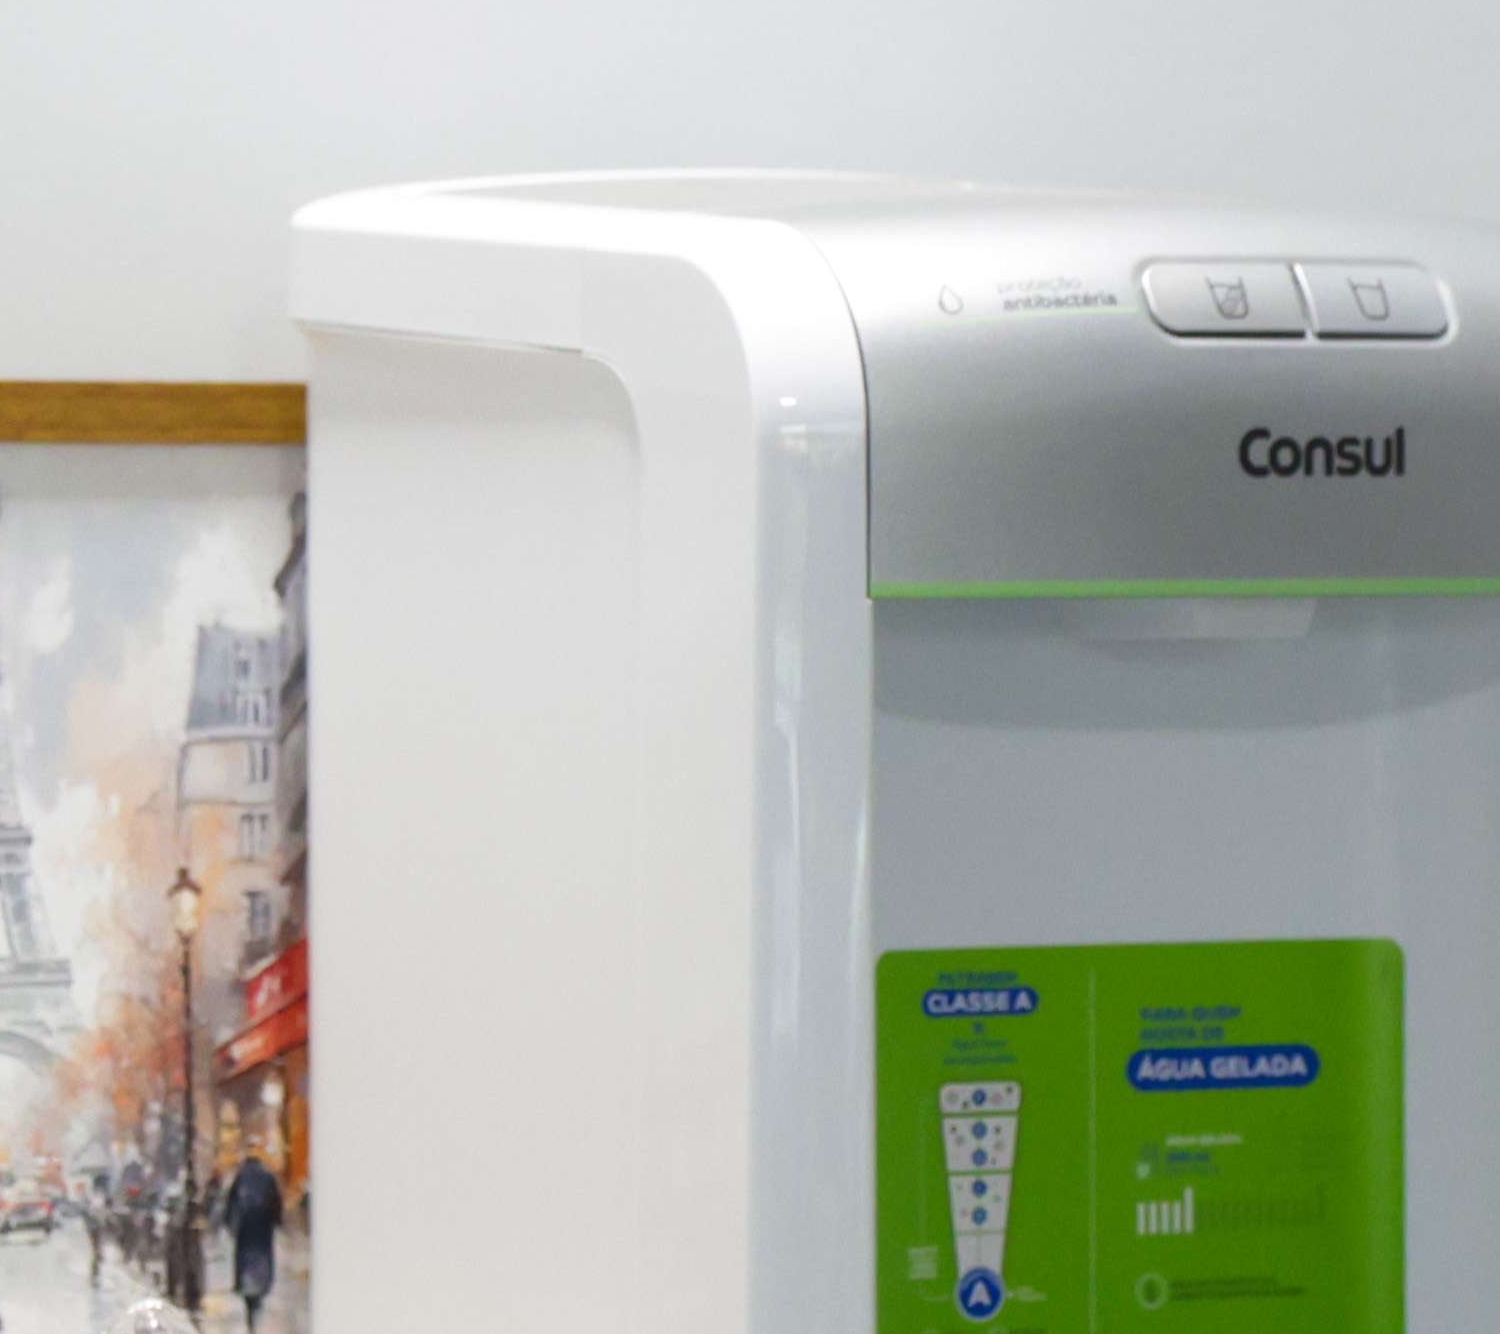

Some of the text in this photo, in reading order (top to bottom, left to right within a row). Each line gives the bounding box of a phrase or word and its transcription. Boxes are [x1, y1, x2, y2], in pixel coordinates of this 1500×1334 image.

[997, 275, 1082, 294] proteção
[1003, 290, 1118, 311] antibactéria
[1238, 426, 1407, 478] Consul
[1014, 990, 1033, 1011] A
[1137, 1052, 1308, 1081] ÁGUA GELADA
[967, 1280, 992, 1308] A
